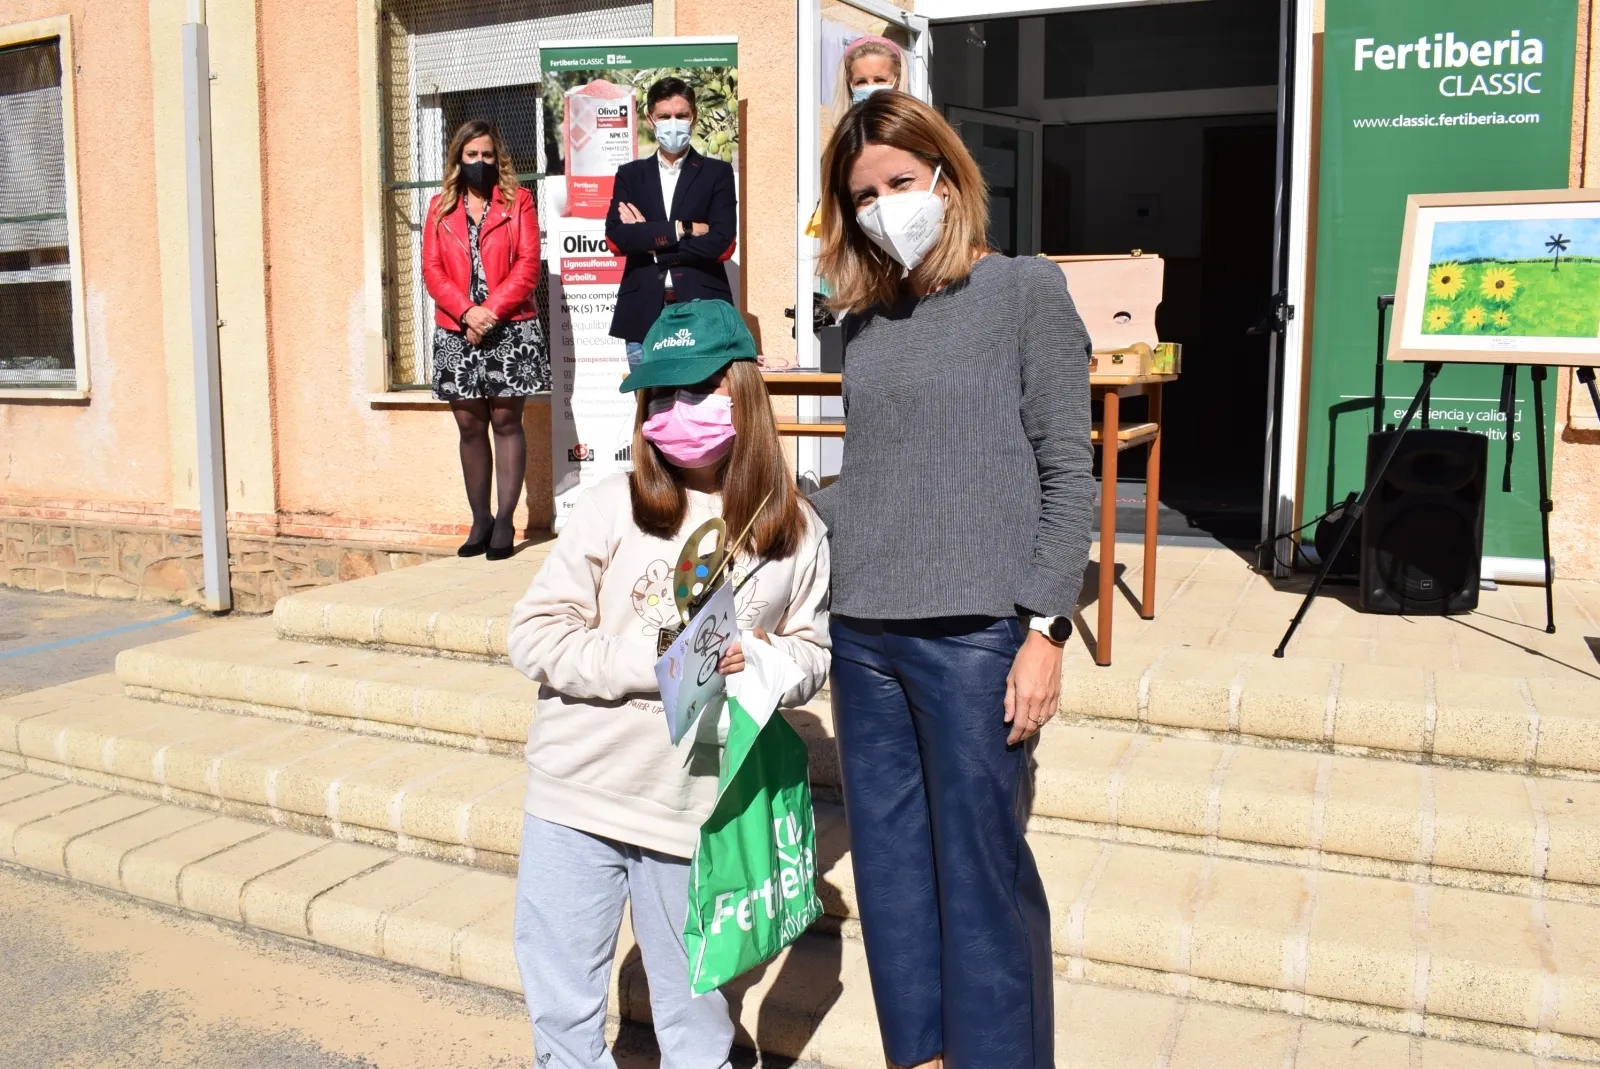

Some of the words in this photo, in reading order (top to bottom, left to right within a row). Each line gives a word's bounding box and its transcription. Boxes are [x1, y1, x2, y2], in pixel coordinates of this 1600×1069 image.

[1354, 30, 1544, 71] Fertiberia
[1439, 72, 1543, 97] CLASSIC
[598, 107, 618, 115] Olivo
[1353, 112, 1540, 128] www.classic.fertiberia.com
[563, 260, 618, 269] Lignosulfonato
[563, 273, 597, 281] Carbolita
[561, 304, 580, 314] NPK
[581, 304, 593, 314] (S)
[562, 336, 574, 346] las
[652, 336, 696, 351] Fertiberia
[1393, 408, 1464, 420] exeiencia
[1466, 411, 1475, 424] y
[1475, 408, 1522, 422] calidd
